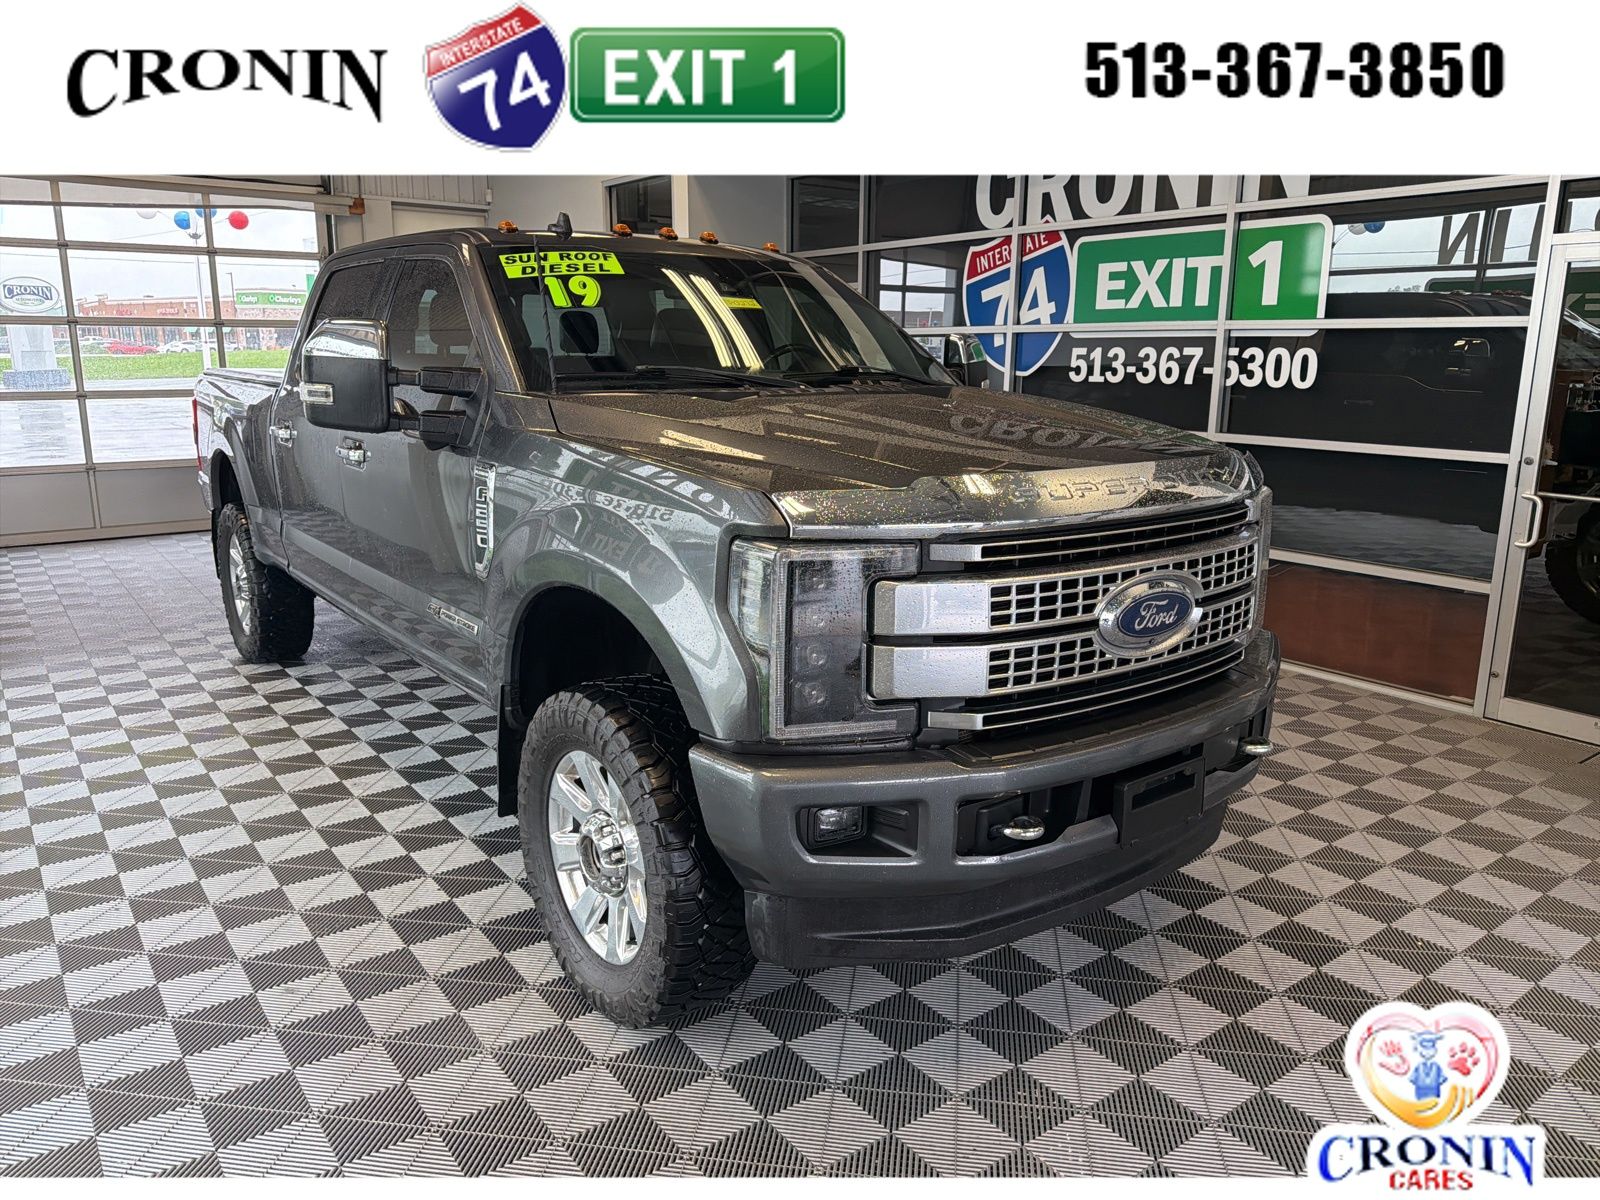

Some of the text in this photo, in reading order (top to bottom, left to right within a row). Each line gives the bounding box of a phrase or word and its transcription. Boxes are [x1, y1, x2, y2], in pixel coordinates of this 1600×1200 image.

[503, 252, 614, 265] SUN ROOF
[521, 262, 611, 276] DIESEL
[976, 231, 1049, 274] INTERATE
[544, 274, 602, 308] 19
[1095, 240, 1283, 310] EXIT 1
[4, 285, 53, 300] CRONIN
[981, 265, 1057, 348] 74
[1068, 346, 1318, 389] 513-367-5300
[1134, 599, 1179, 631] Ford
